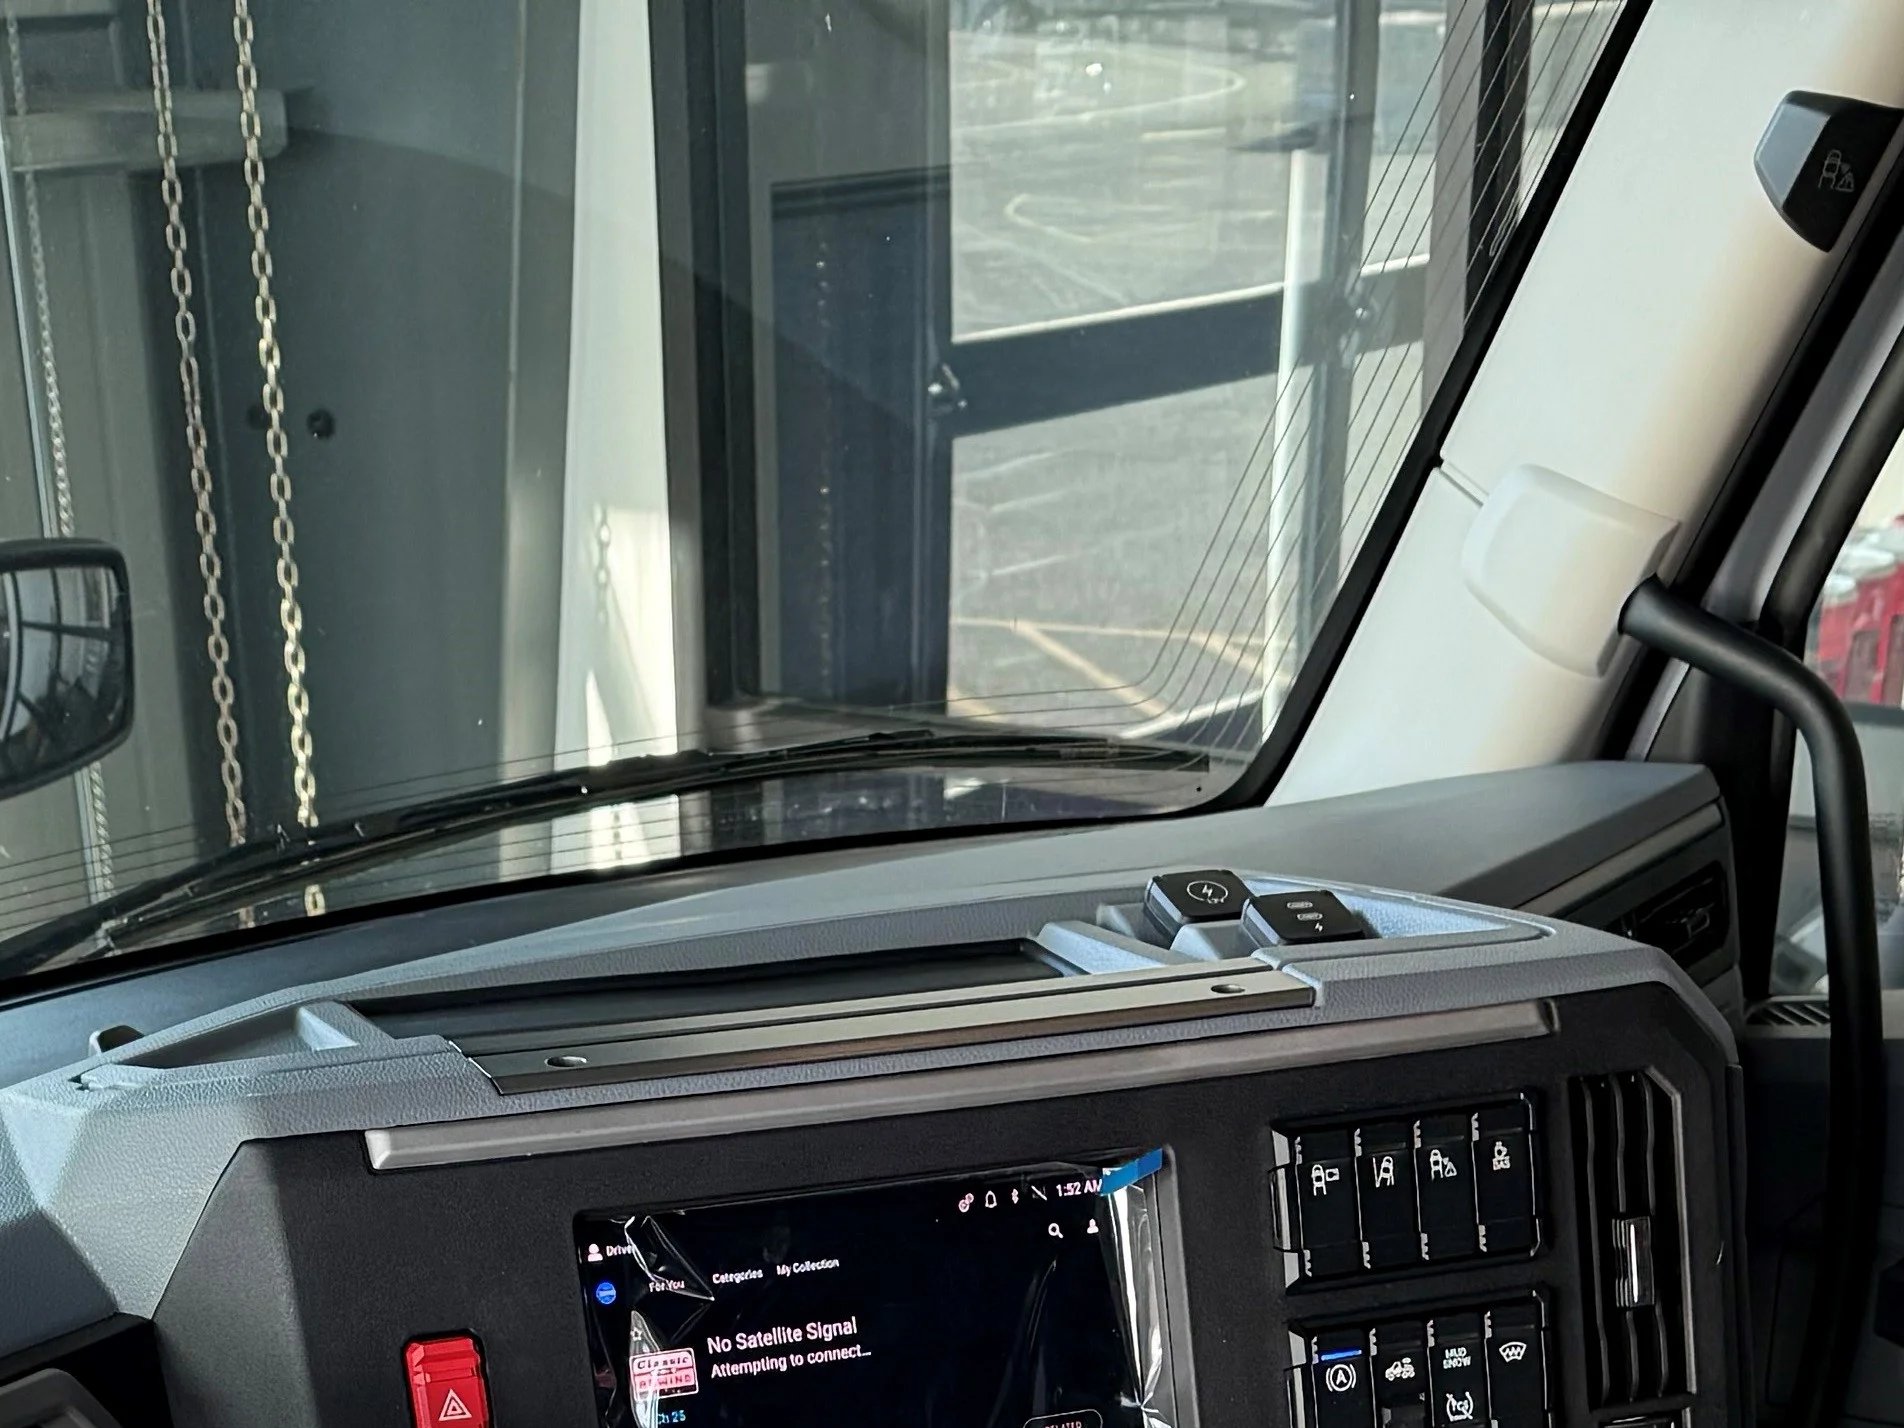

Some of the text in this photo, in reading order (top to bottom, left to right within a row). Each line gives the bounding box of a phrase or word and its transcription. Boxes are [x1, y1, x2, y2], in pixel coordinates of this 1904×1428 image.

[712, 1267, 764, 1285] Categories
[776, 1264, 792, 1279] My
[792, 1257, 840, 1274] Collection
[707, 1316, 858, 1355] No Satellite Signal
[711, 1343, 872, 1380] Attempting to connect...
[1442, 1356, 1472, 1370] SNOW
[1444, 1347, 1467, 1359] MUD
[672, 1409, 686, 1423] 25
